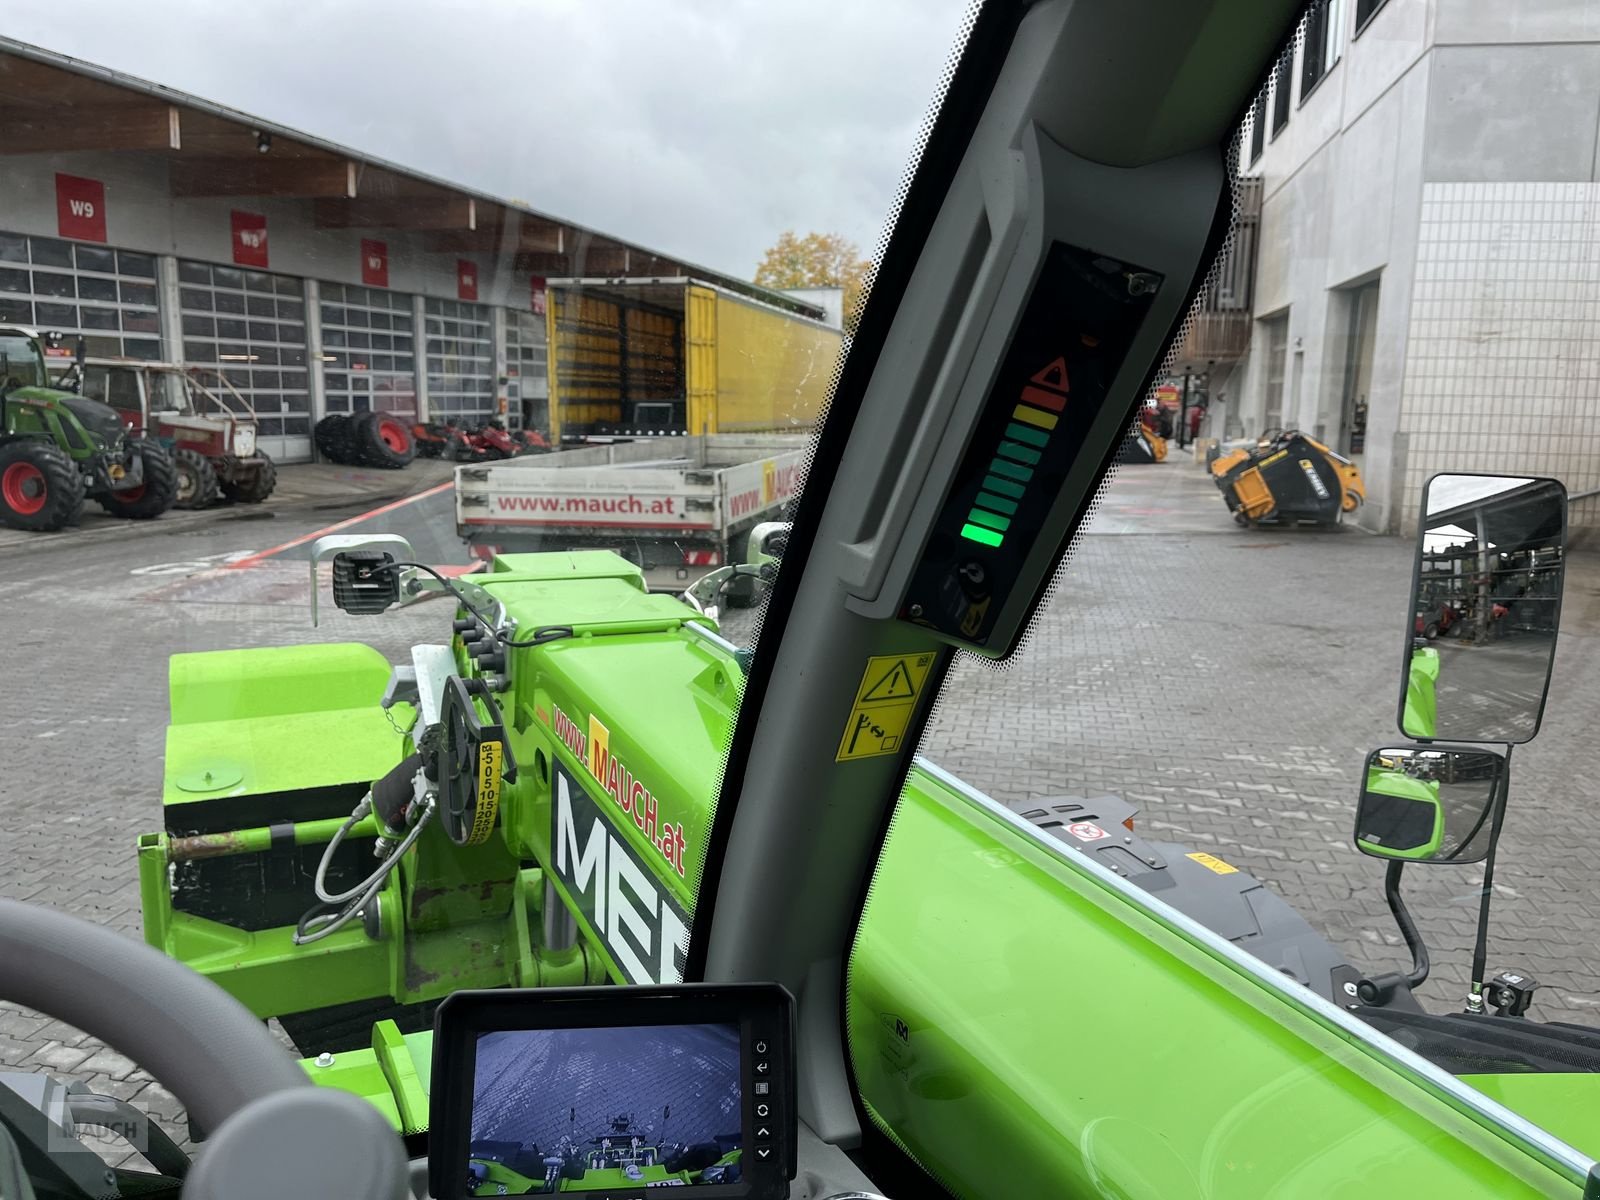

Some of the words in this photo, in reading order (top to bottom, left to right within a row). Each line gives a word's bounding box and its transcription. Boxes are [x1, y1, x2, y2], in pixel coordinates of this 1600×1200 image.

[70, 199, 94, 218] W9
[498, 495, 675, 514] www.mauch.at
[485, 766, 492, 777] 0
[484, 778, 492, 789] 5
[480, 790, 495, 800] 10
[554, 704, 685, 877] www.MAUCH.at
[479, 801, 494, 810] 15
[477, 811, 492, 819] 20
